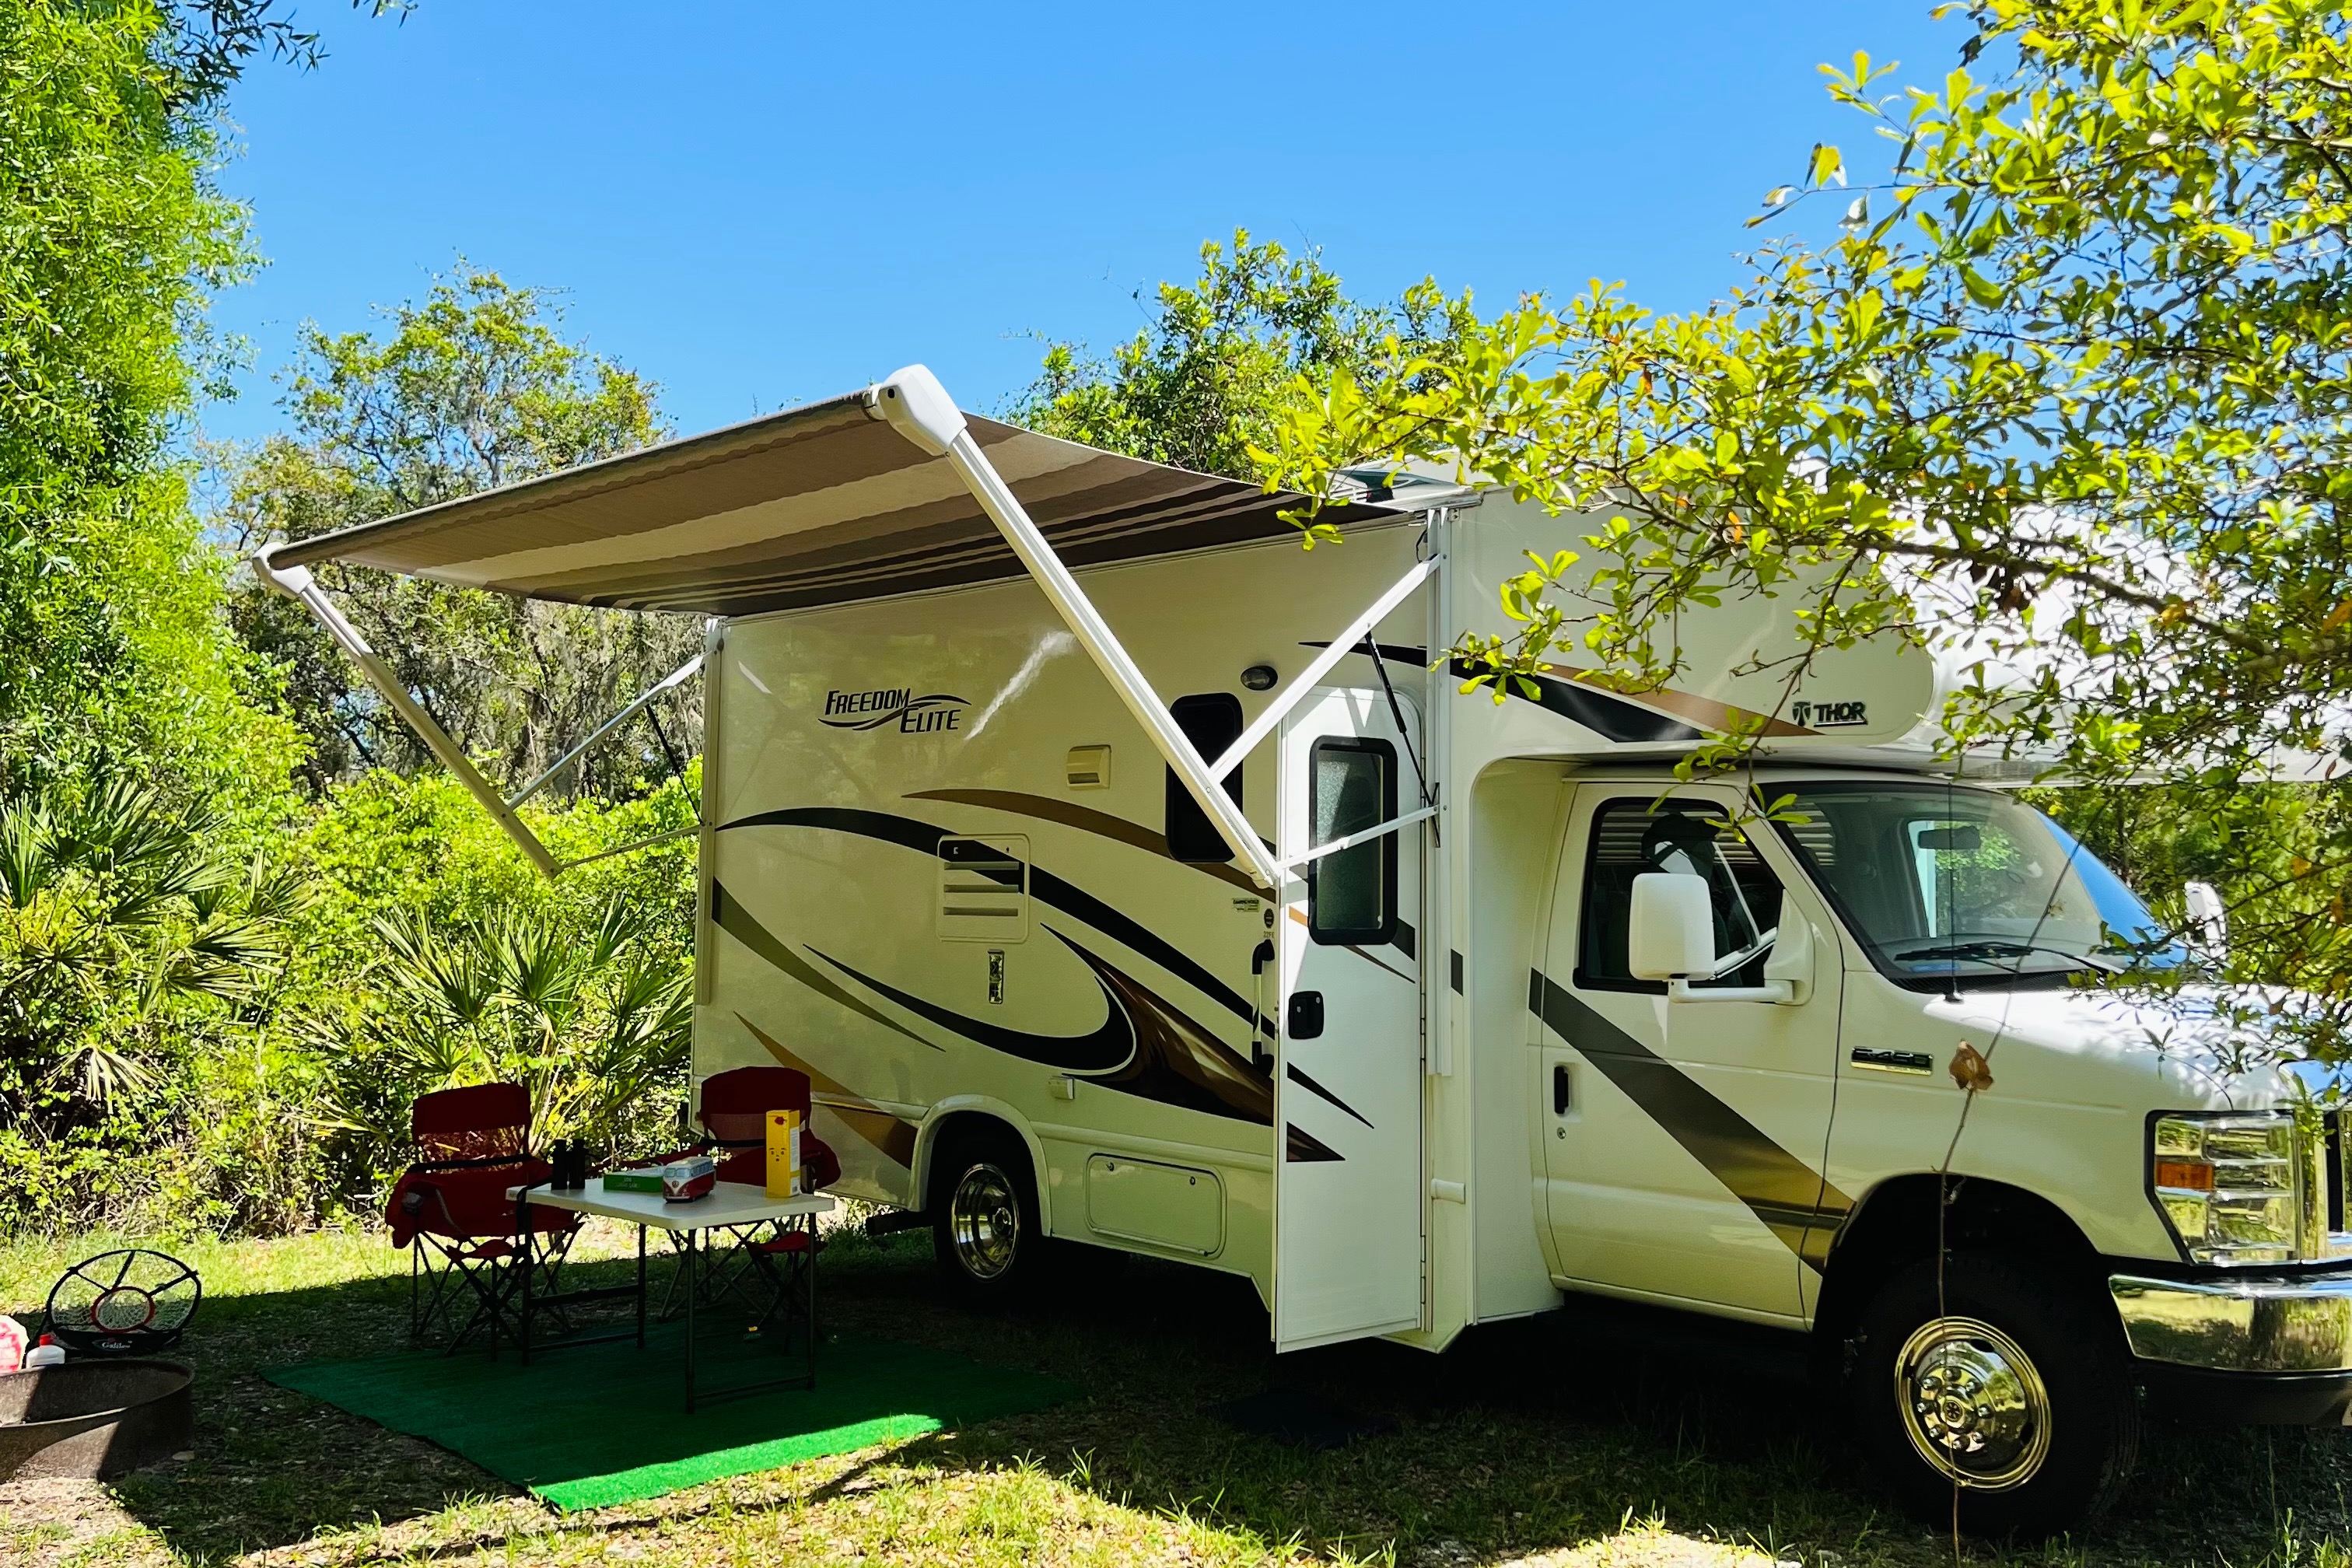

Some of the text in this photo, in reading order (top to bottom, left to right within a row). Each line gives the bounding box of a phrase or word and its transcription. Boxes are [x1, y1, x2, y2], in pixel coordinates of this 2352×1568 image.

[824, 688, 911, 715] FREEDOM
[1813, 702, 1868, 725] THOR
[900, 706, 961, 733] ELITE
